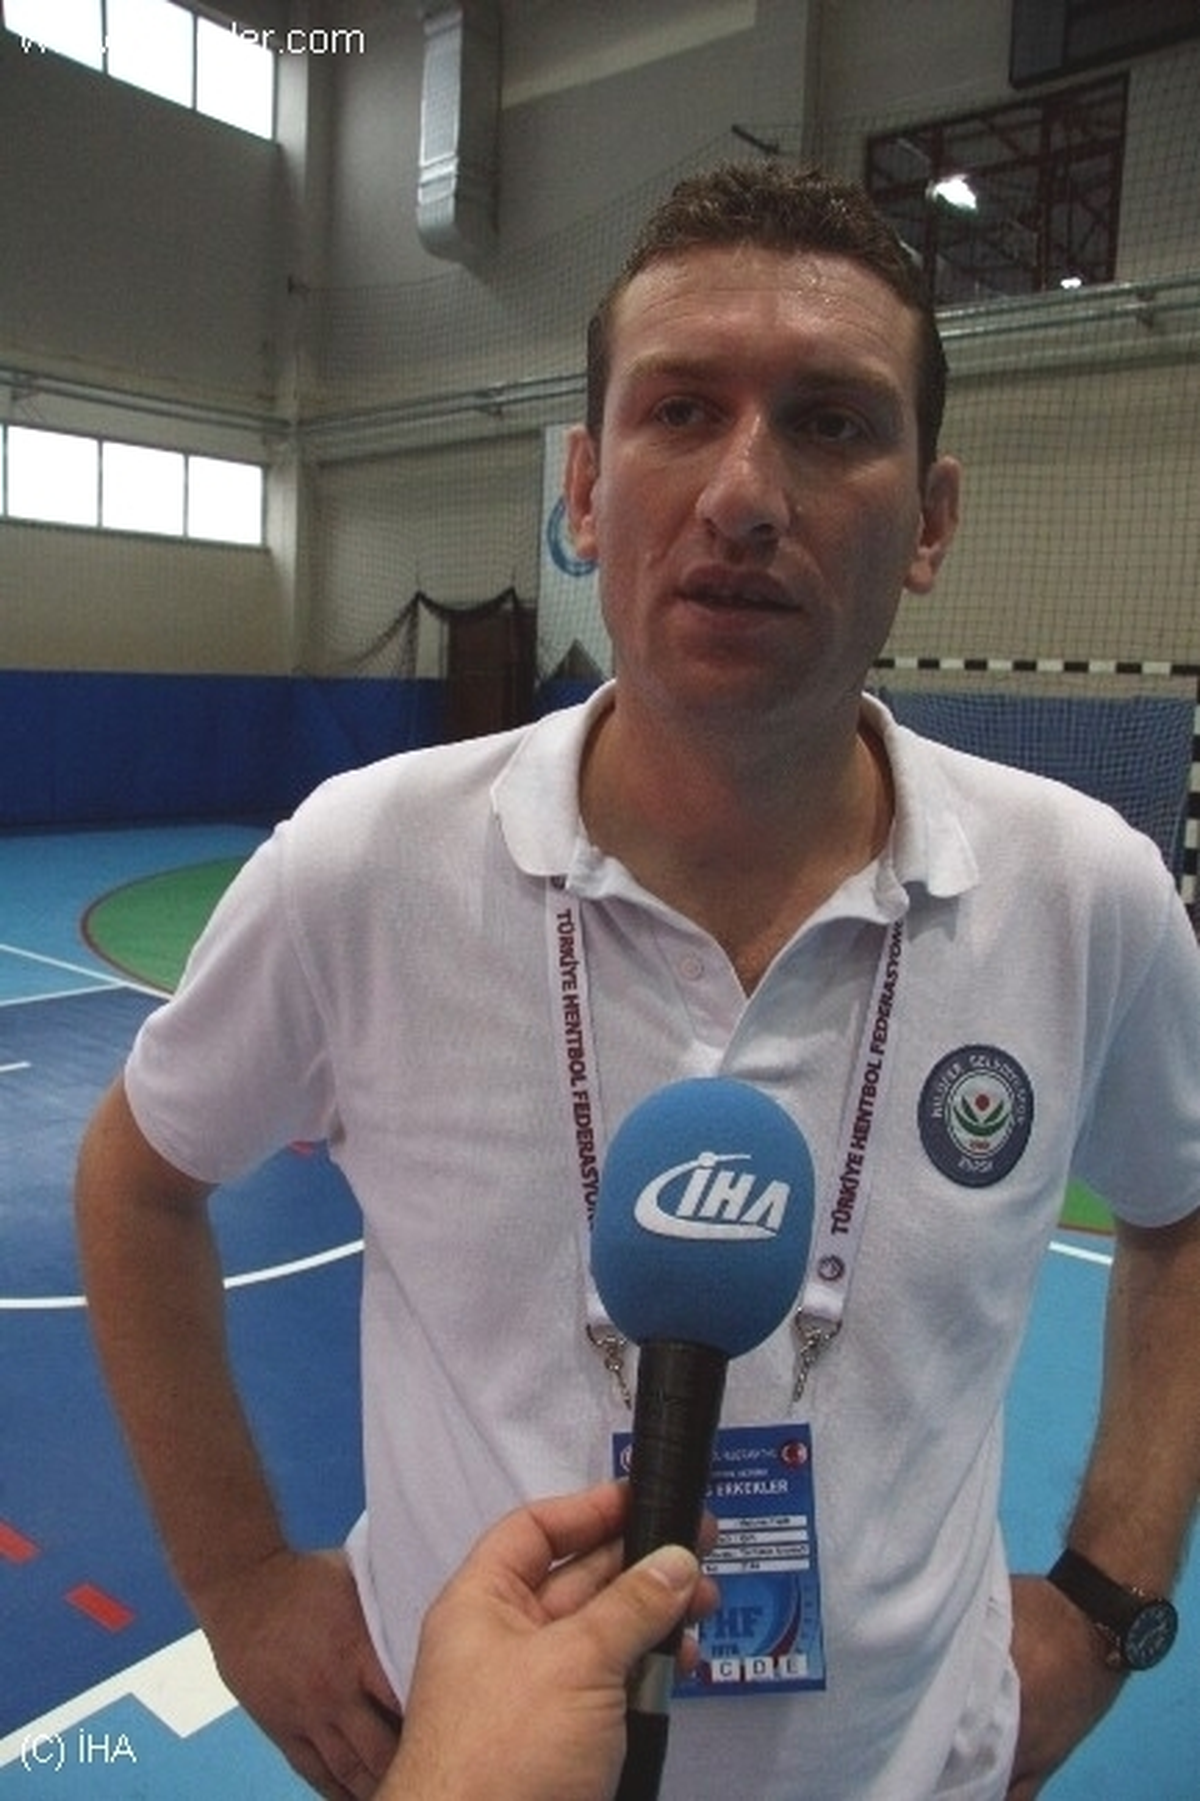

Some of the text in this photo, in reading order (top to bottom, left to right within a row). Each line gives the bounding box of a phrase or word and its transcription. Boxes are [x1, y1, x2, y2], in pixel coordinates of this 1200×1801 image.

[556, 908, 580, 992] TÜRKİYE
[562, 994, 588, 1088] HENTBOL
[831, 1152, 866, 1235] TÜRKİYE
[850, 1057, 883, 1151] HENTBOL
[719, 1661, 733, 1678] C
[752, 1658, 766, 1675] D
